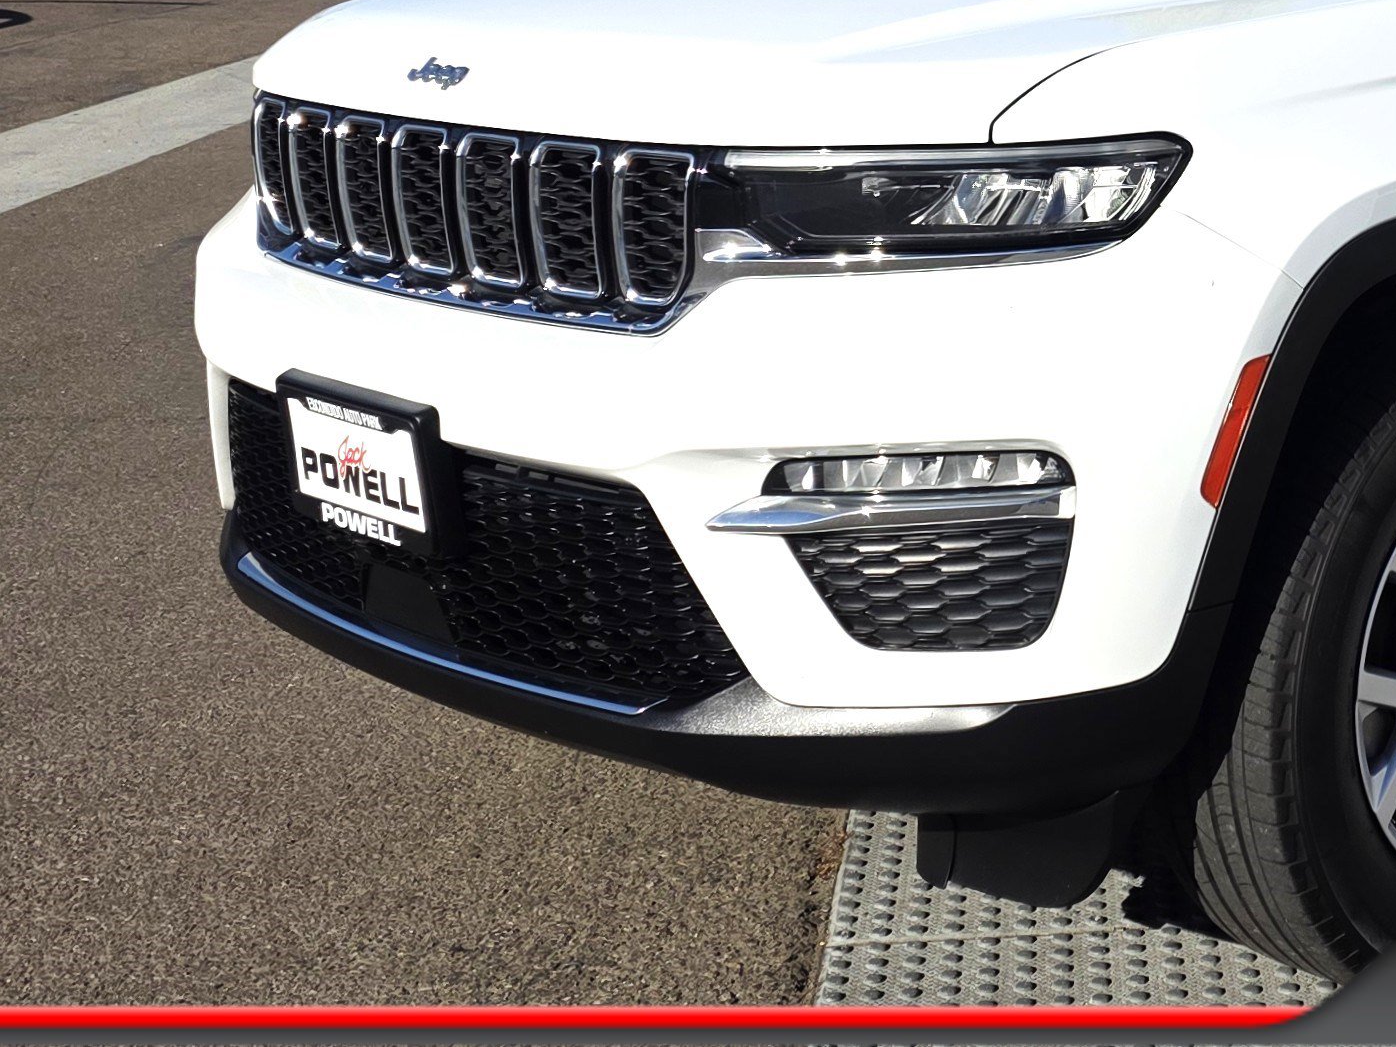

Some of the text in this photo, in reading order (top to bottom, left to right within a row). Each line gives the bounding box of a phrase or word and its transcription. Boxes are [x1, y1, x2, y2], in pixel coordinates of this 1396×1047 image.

[407, 57, 470, 90] Jeep
[343, 407, 363, 427] AUTO
[360, 412, 383, 431] PARK
[337, 435, 371, 479] Jack
[301, 446, 420, 516] POWELL
[320, 501, 402, 547] POWELL
